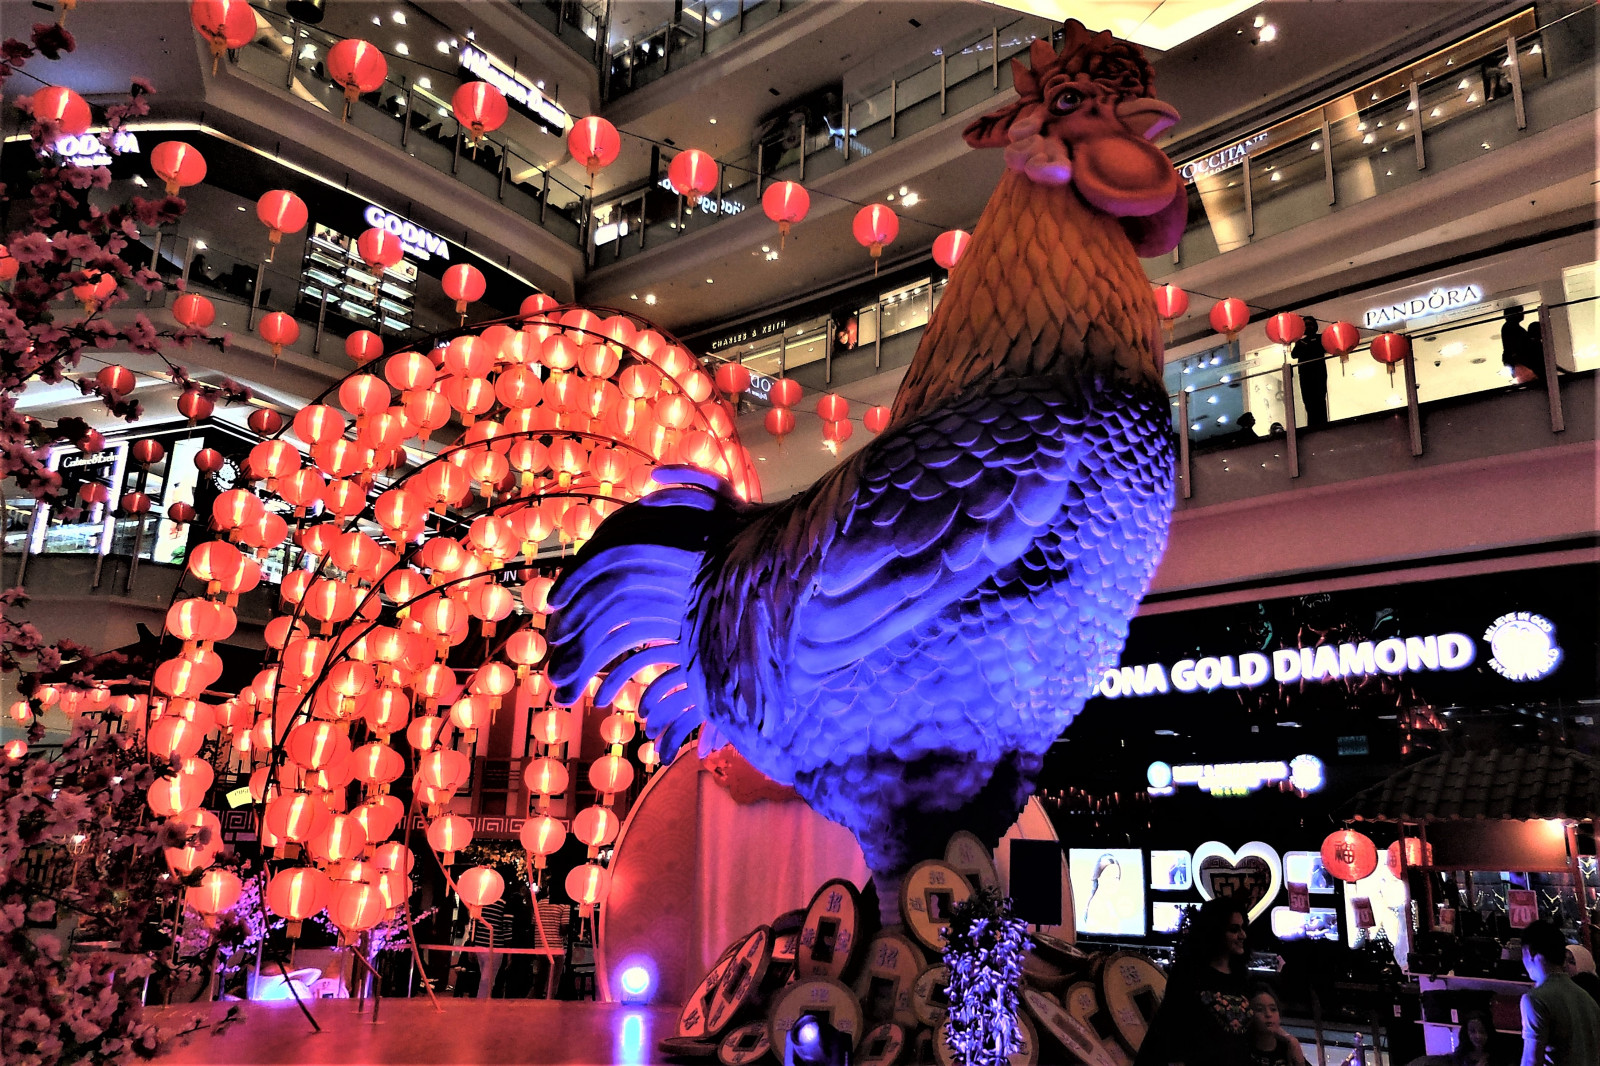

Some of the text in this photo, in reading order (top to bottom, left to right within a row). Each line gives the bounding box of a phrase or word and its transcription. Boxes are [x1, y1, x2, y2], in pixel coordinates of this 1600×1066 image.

[364, 205, 450, 260] GODIVA
[1366, 285, 1478, 326] PANDORA
[712, 332, 747, 349] CHARLES
[762, 320, 786, 334] KEITH
[1092, 632, 1476, 698] ONA GOLD DIAMOND
